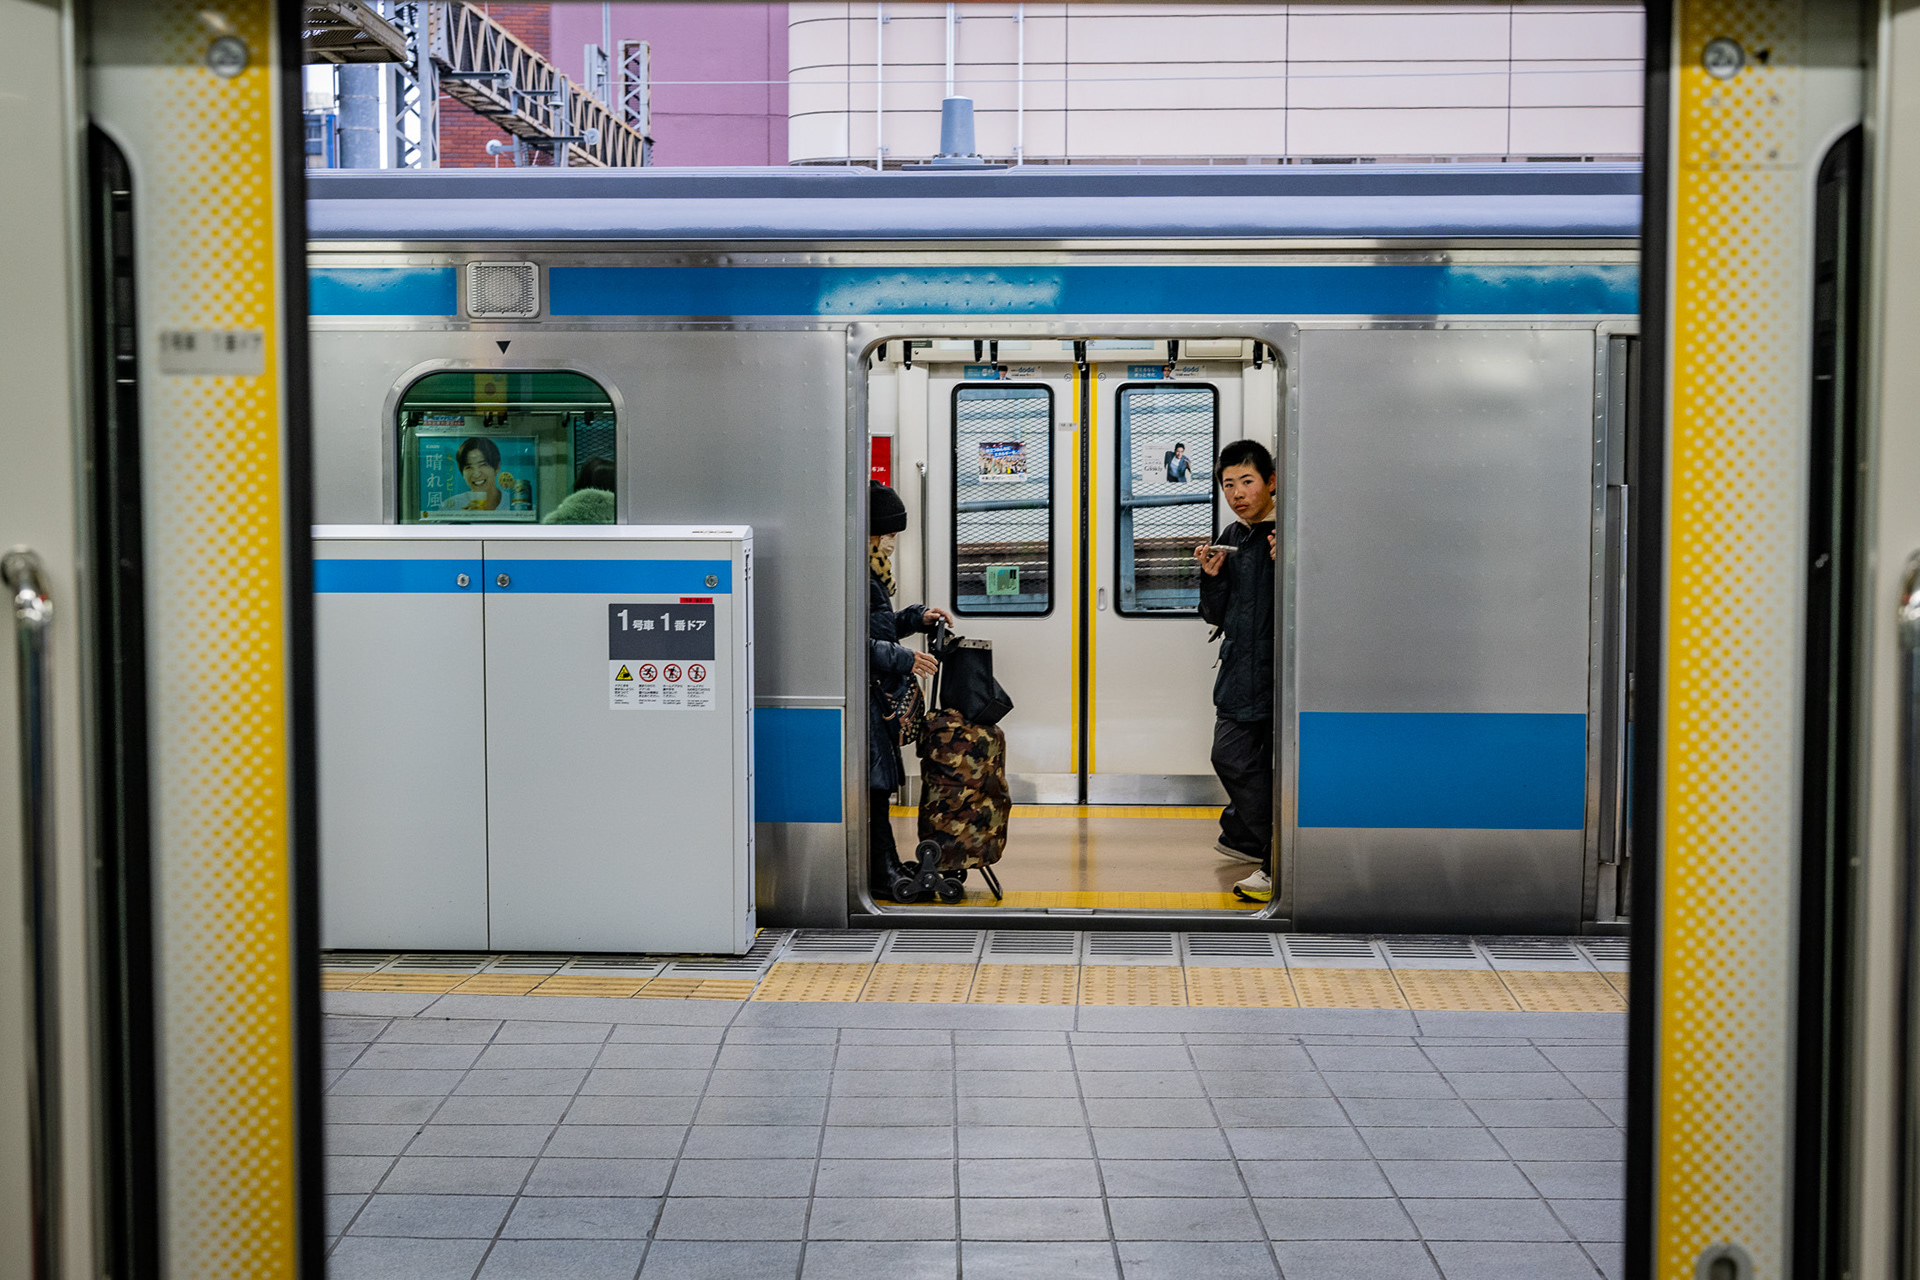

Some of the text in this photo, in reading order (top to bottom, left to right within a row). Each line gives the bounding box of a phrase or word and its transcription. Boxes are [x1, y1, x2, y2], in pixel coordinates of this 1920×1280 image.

[426, 453, 444, 508] 晴れ風
[617, 609, 706, 631] 1号車 1番ドア
